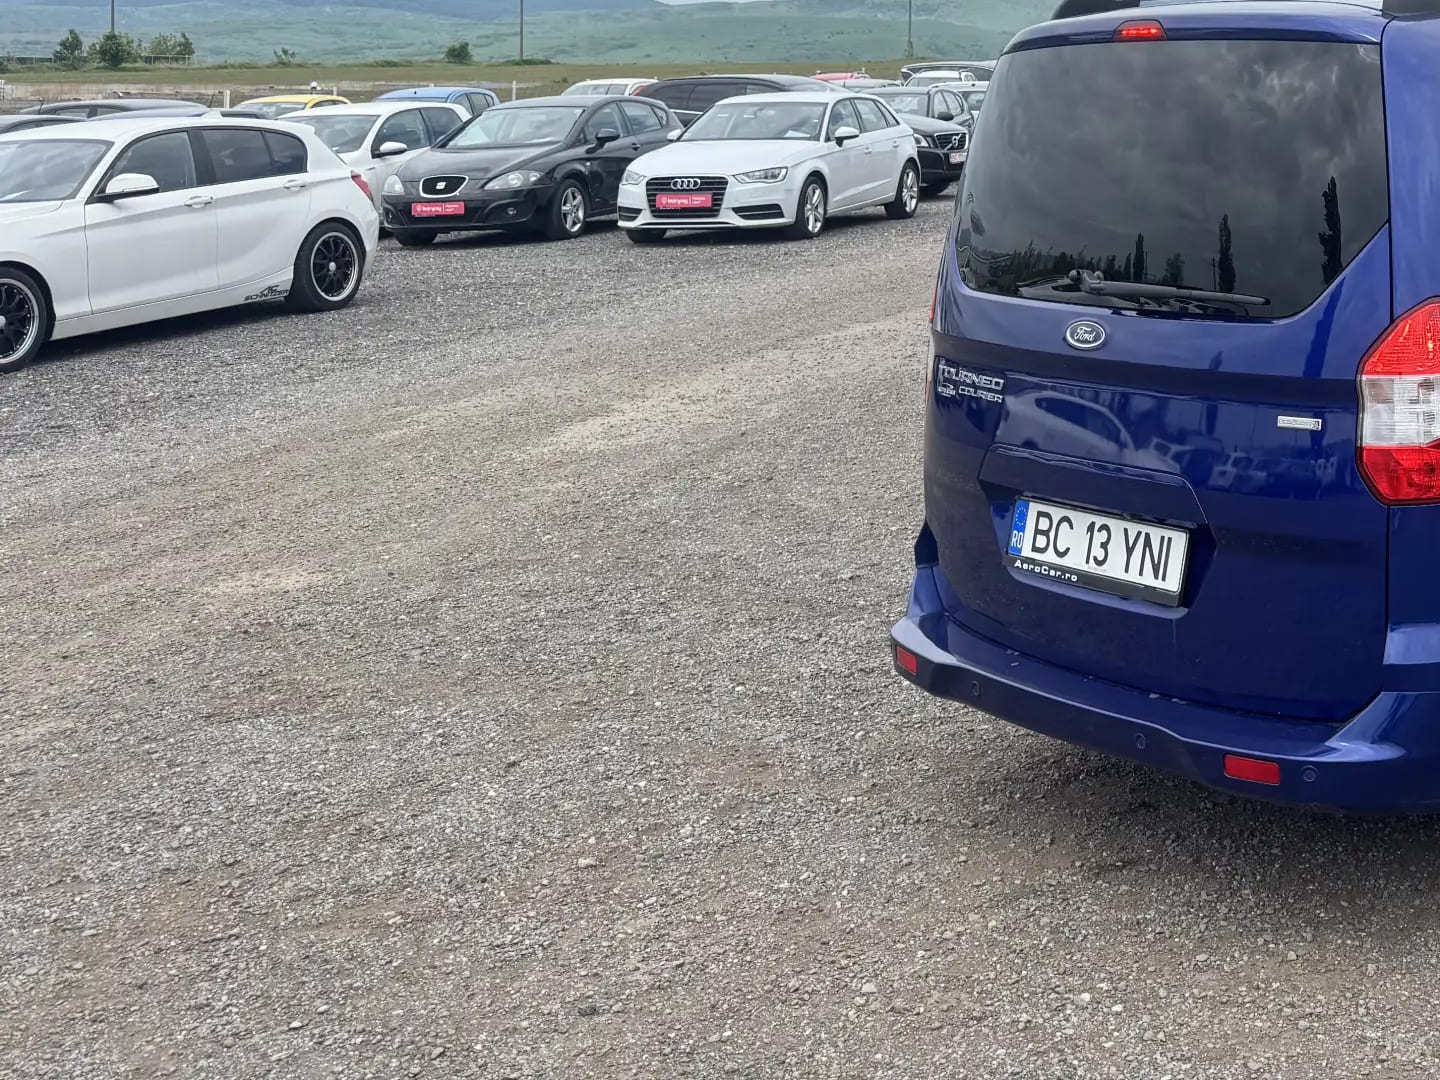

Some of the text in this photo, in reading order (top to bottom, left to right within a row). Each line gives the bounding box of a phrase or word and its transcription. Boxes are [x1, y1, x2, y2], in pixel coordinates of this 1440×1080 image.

[1073, 326, 1097, 342] Ford
[938, 363, 1004, 391] TOURNEO
[958, 385, 1003, 403] COURIER
[1011, 530, 1024, 548] RO
[1031, 510, 1173, 582] BC 13 YNI
[1014, 559, 1078, 582] AeroCar.ro
